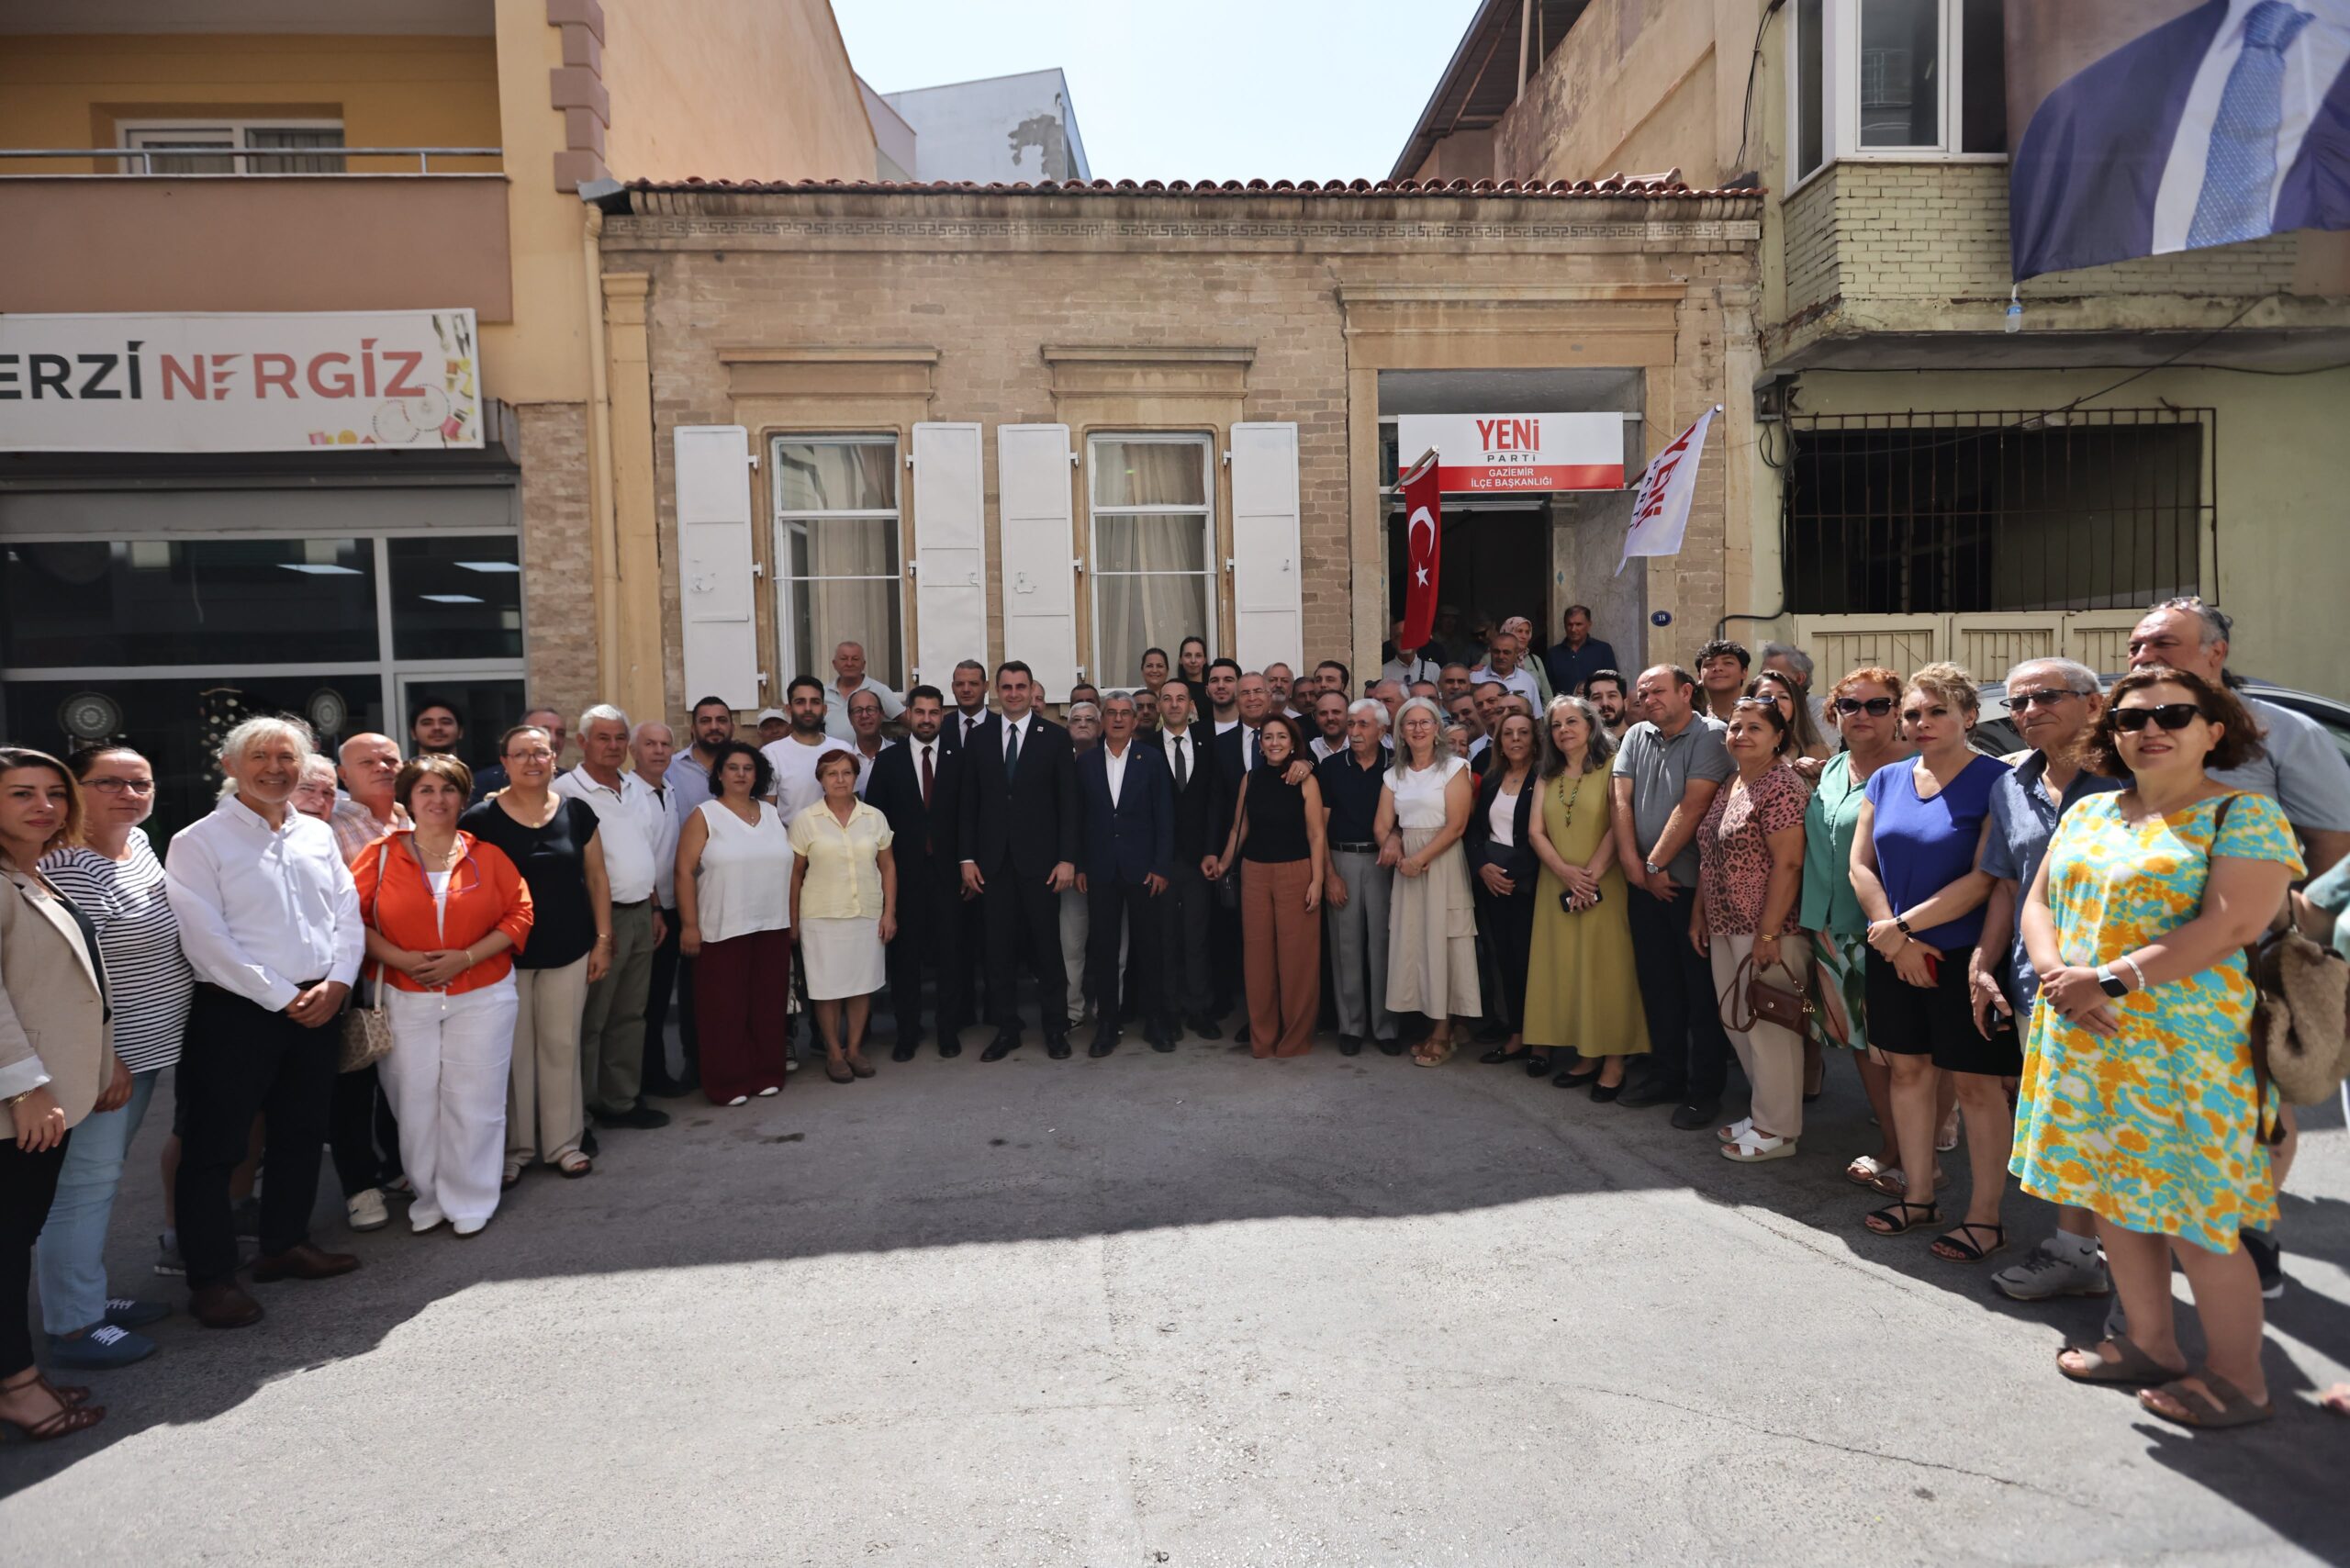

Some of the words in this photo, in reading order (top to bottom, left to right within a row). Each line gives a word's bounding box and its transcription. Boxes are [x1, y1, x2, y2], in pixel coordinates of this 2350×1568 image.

[160, 338, 426, 400] NERGİZ
[1488, 466, 1534, 477] GAZİEMİR
[1471, 477, 1493, 488] İLÇE
[1494, 476, 1552, 487] BAŞKANLIĞI
